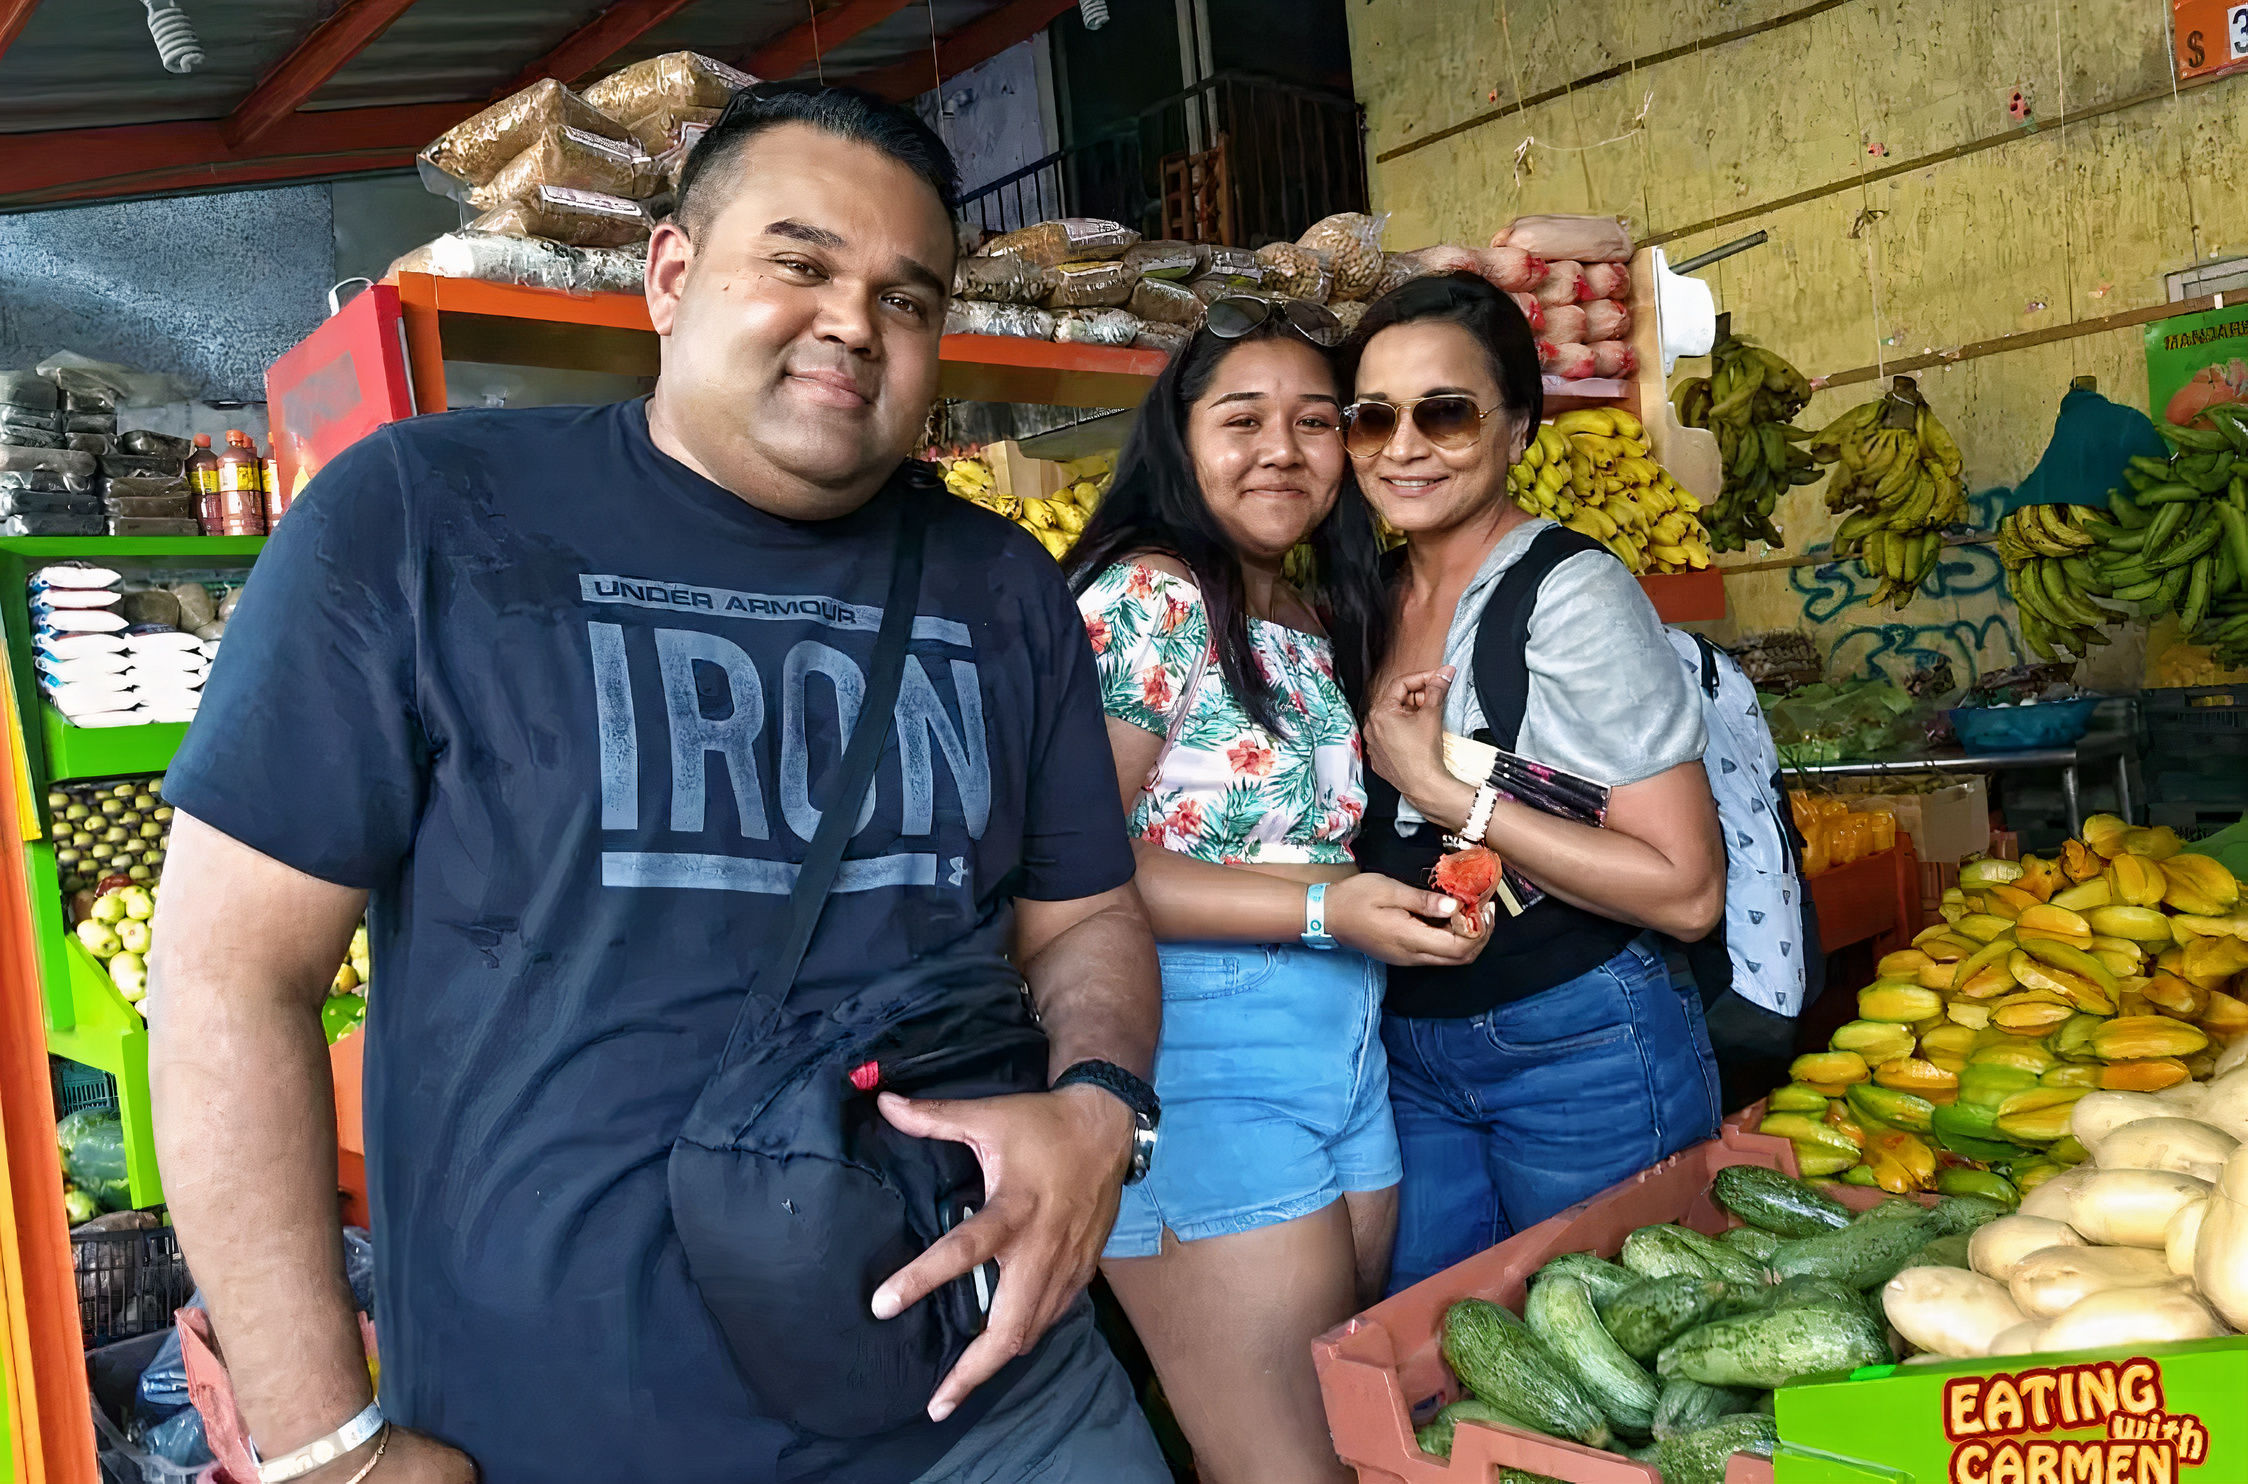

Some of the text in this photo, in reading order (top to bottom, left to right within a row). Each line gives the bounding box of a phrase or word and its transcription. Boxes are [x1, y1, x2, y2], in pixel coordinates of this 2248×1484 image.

[594, 580, 857, 625] UNDER ARMOUR
[587, 620, 992, 842] IRON
